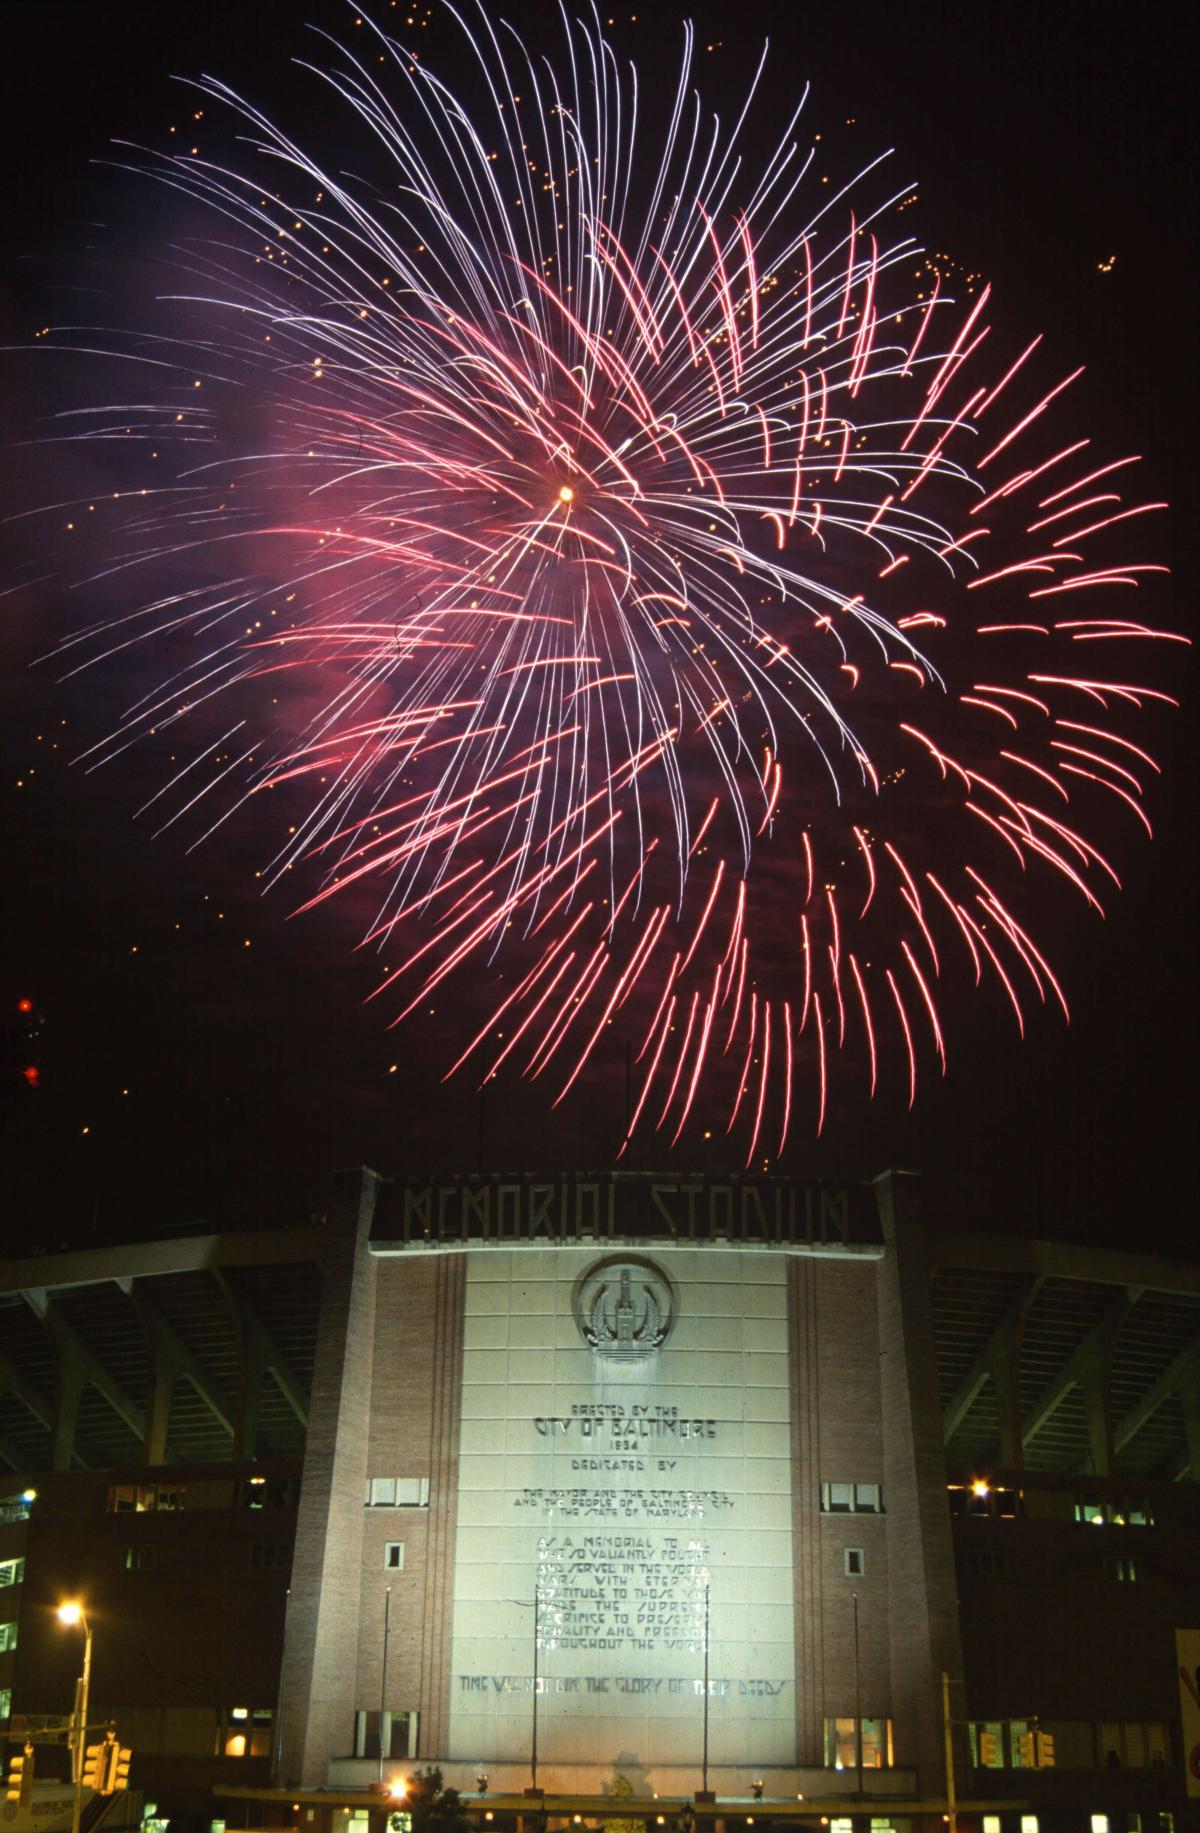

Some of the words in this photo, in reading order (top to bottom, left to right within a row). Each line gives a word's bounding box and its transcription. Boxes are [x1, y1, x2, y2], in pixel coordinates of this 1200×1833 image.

[403, 1183, 627, 1242] MEMORIAL
[649, 1183, 849, 1243] STADIUM
[571, 1404, 625, 1417] ERECTED
[631, 1405, 649, 1417] BY
[656, 1406, 679, 1418] THE
[534, 1417, 572, 1437] CITY
[582, 1418, 604, 1437] OF
[611, 1418, 716, 1439] BALTIMORE
[571, 1459, 645, 1471] DEDICATED
[658, 1460, 678, 1471] BY
[523, 1488, 544, 1498] THE
[549, 1489, 587, 1498] MAYOR
[593, 1489, 618, 1499] AND
[623, 1490, 644, 1499] THE
[650, 1490, 673, 1499] CITY
[513, 1498, 538, 1507] AND
[544, 1498, 565, 1508] THE
[571, 1499, 613, 1508] PEOPLE
[619, 1499, 634, 1508] OF
[641, 1499, 704, 1510] BALTIMORE
[711, 1500, 736, 1510] CITY
[559, 1508, 579, 1517] THE
[583, 1508, 619, 1517] STATE
[624, 1508, 639, 1517] OF
[646, 1508, 707, 1519] MARYLAND
[537, 1537, 557, 1548] AS
[563, 1537, 574, 1548] A
[584, 1537, 653, 1549] MEMORIAL
[664, 1538, 678, 1549] TO
[569, 1548, 586, 1559] SO
[589, 1548, 655, 1560] VALIANTLY
[568, 1563, 616, 1574] SERVED
[623, 1564, 634, 1574] IN
[640, 1565, 661, 1575] THE
[595, 1575, 628, 1586] WITH
[536, 1588, 605, 1599] GRATITUDE
[613, 1588, 628, 1599] TO
[634, 1588, 674, 1599] THOSE
[682, 1589, 705, 1600] WH
[595, 1601, 620, 1611] THE
[637, 1602, 706, 1613] SUPREM
[613, 1613, 629, 1624] TO
[637, 1614, 706, 1625] PRESERV
[606, 1626, 634, 1637] AND
[631, 1639, 655, 1649] THE
[666, 1640, 706, 1651] WORL
[460, 1676, 488, 1692] TIME
[493, 1676, 520, 1692] WILL
[526, 1677, 552, 1693] NOT
[585, 1677, 610, 1693] THE
[615, 1678, 663, 1694] GLORY
[668, 1679, 687, 1694] OF
[737, 1680, 788, 1696] DEEDS
